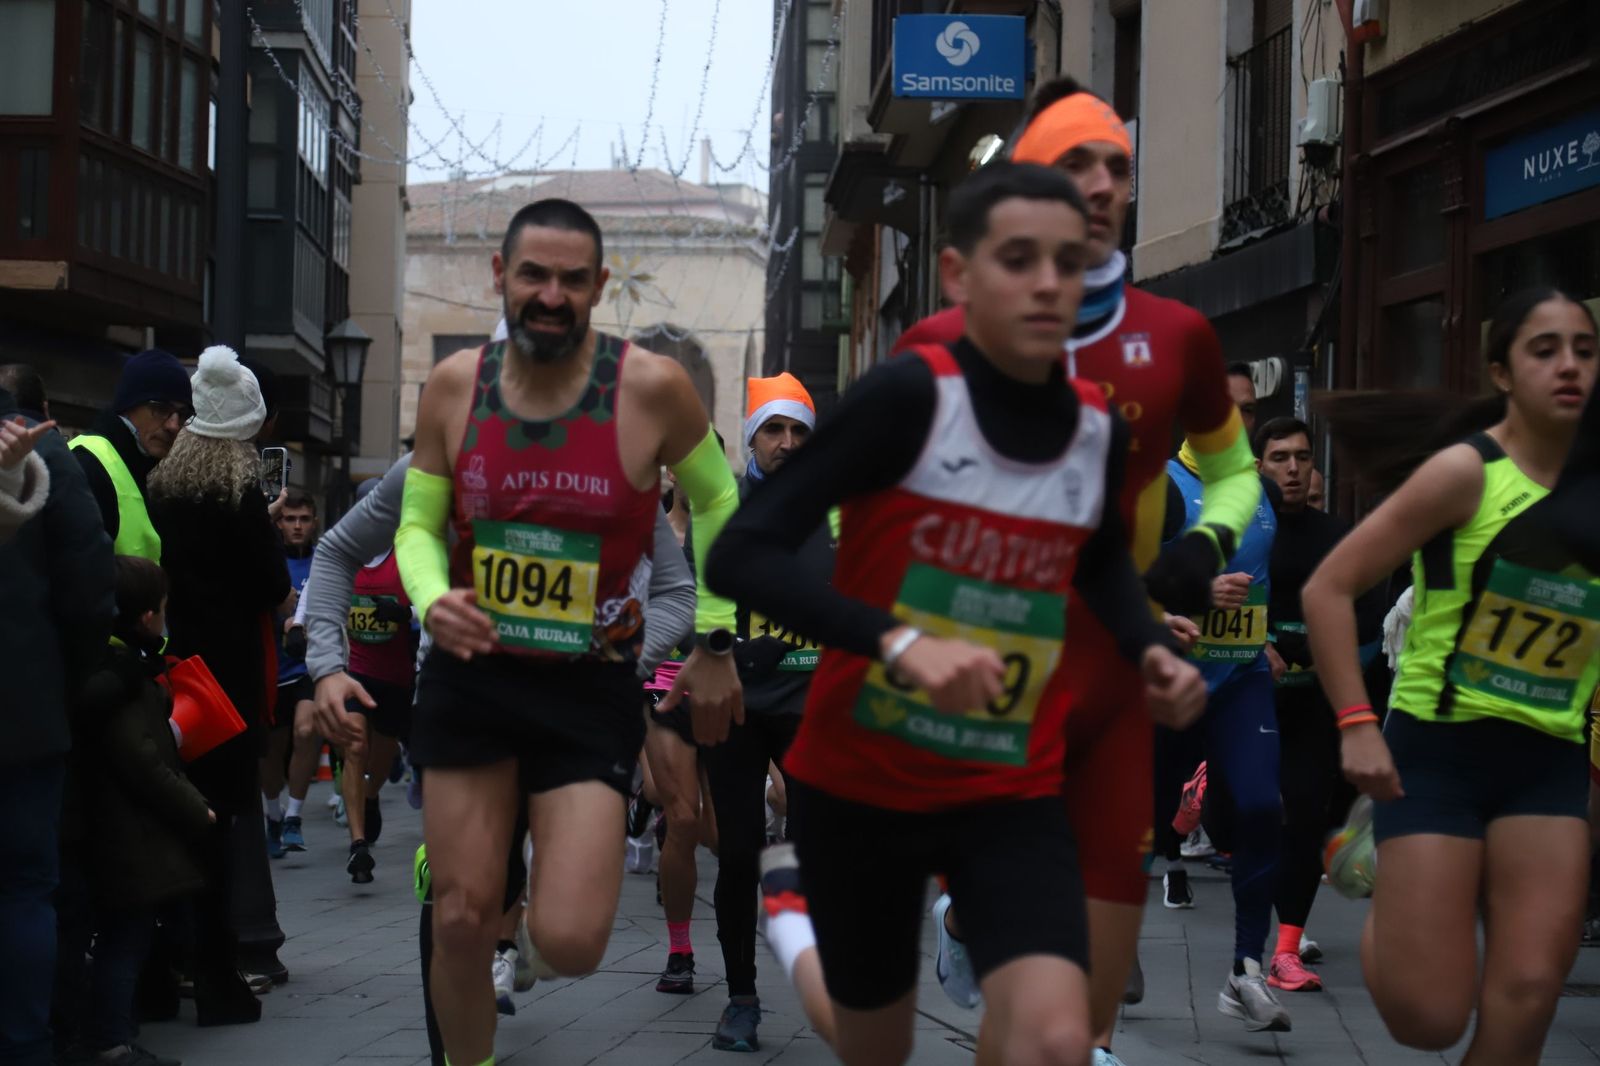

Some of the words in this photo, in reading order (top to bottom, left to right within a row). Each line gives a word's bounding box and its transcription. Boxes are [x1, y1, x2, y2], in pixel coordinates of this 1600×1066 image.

[902, 73, 1015, 93] Samsonite
[1523, 140, 1578, 180] NUXE
[501, 471, 550, 490] APIS
[555, 472, 610, 496] DURI
[479, 553, 573, 612] 1094
[496, 621, 530, 639] CAJA
[533, 627, 583, 645] RURAL
[1201, 608, 1254, 638] 1041
[1489, 605, 1582, 668] 172
[779, 656, 798, 665] AJA
[799, 655, 821, 665] RUR
[1208, 648, 1231, 658] CAJA
[1490, 672, 1527, 695] CAJA
[1530, 685, 1569, 702] RURAL
